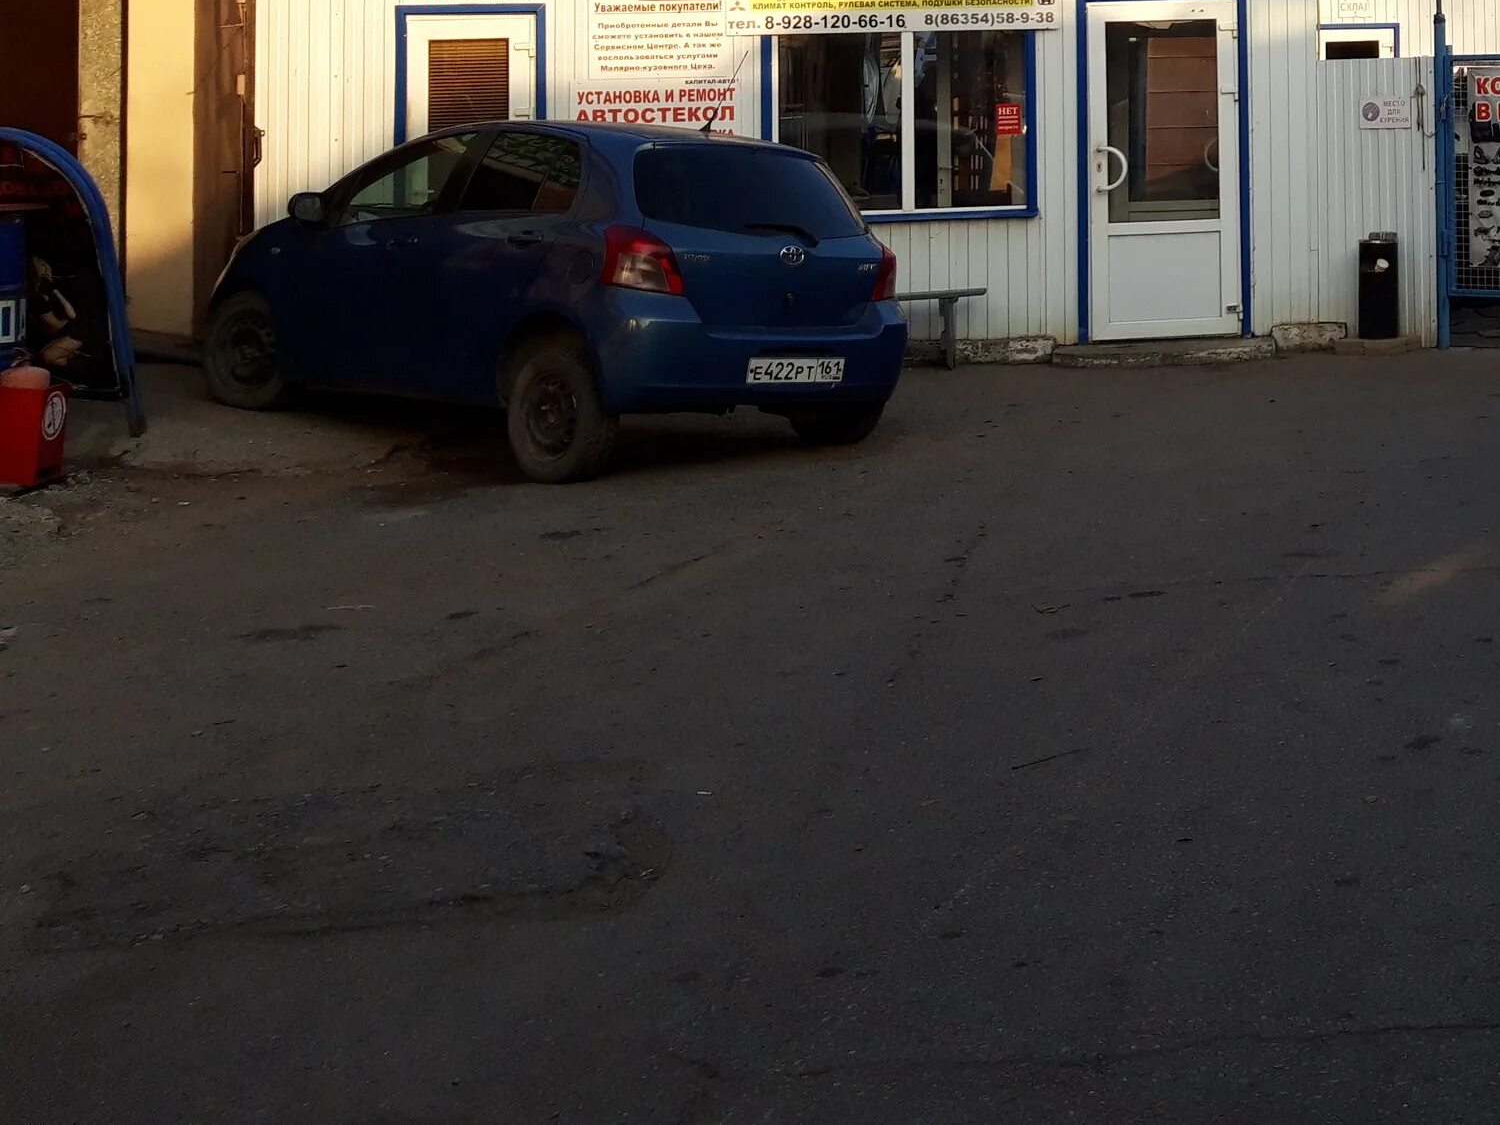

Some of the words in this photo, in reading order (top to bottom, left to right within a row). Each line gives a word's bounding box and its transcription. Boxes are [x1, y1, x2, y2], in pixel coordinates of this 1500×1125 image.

[594, 2, 656, 13] Уважаемые
[659, 0, 722, 13] покупатели!
[752, 2, 786, 10] КЛИМАТ
[838, 1, 876, 9] РУЛЕВАЯ
[878, 0, 919, 8] СИСТЕМА,
[922, 0, 963, 7] ПОДУШКИ
[727, 19, 761, 29] тел.
[924, 12, 1054, 26] 8(86354)58-9-38
[634, 32, 683, 40] установить
[676, 53, 718, 61] услугами
[577, 90, 660, 105] УСТАНОВКА
[665, 90, 674, 103] И
[679, 88, 735, 103] РЕМОНТ
[576, 106, 735, 123] АВТОСТЕКОЛ
[1476, 101, 1490, 121] В
[819, 361, 840, 375] 161
